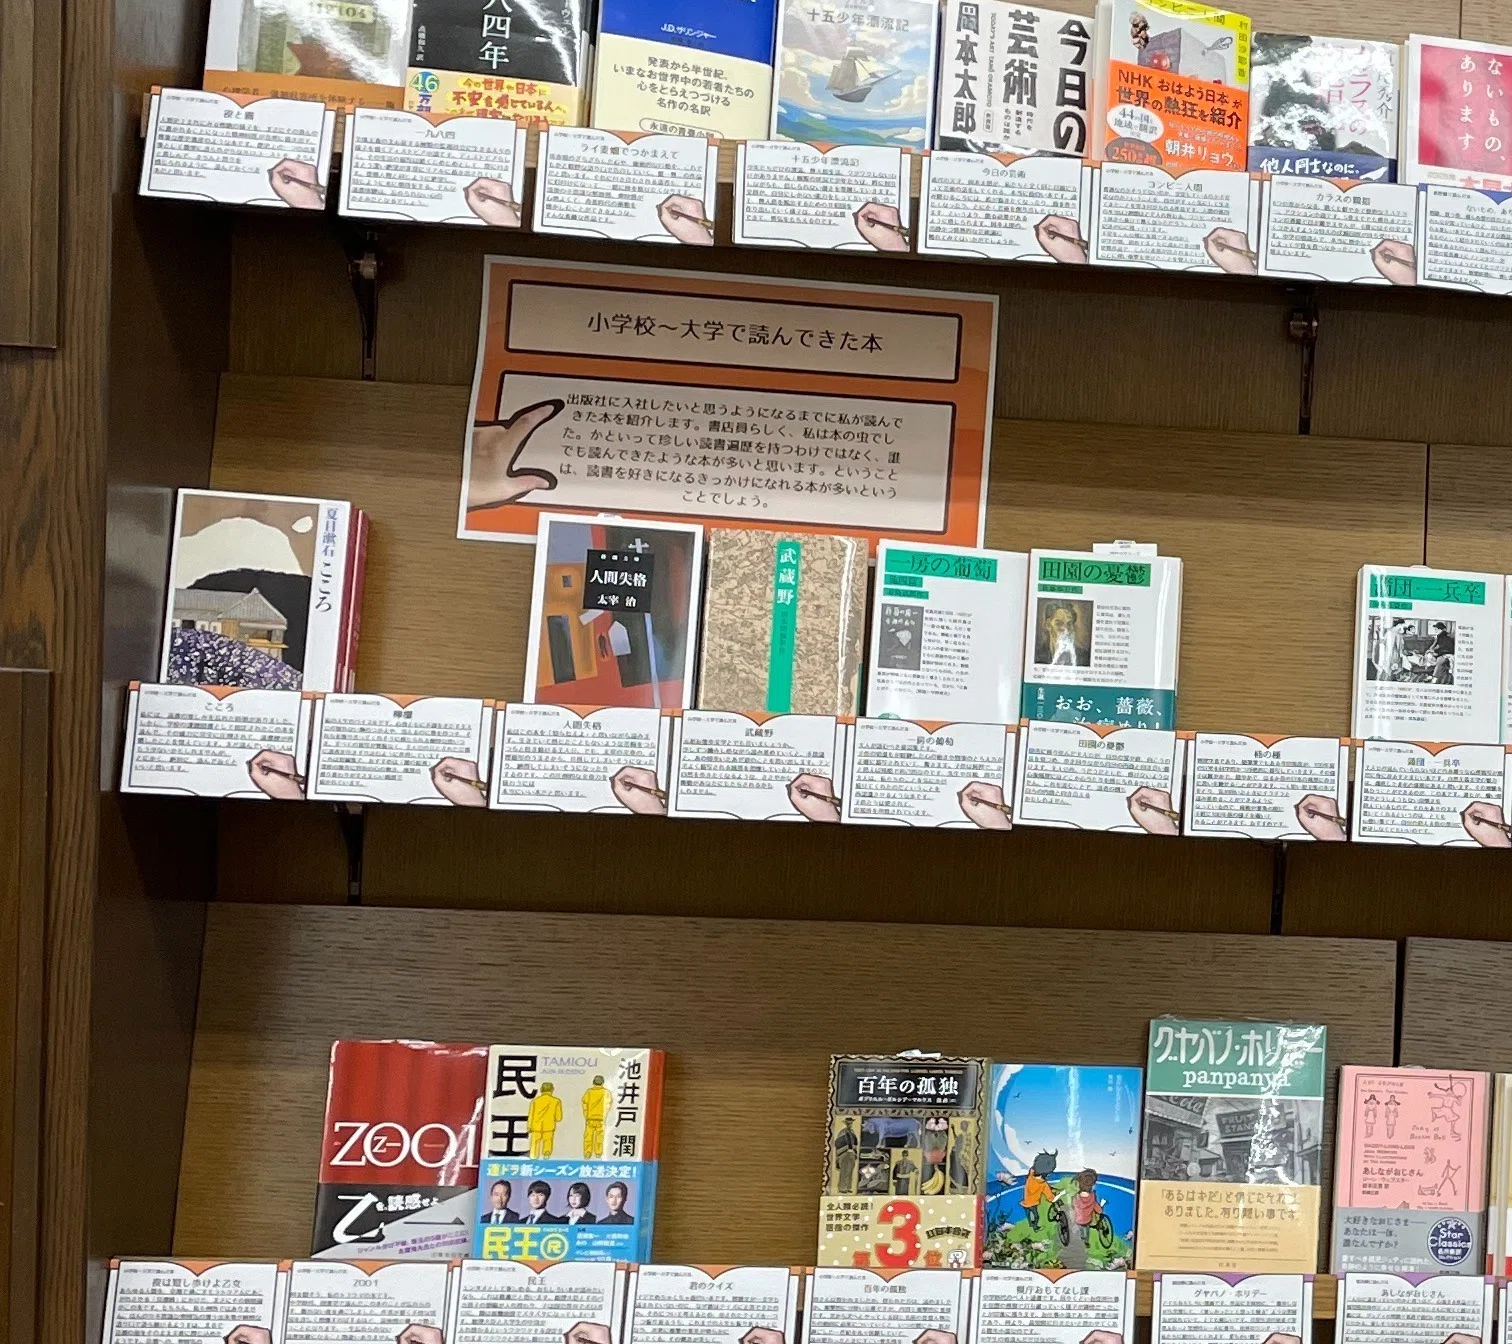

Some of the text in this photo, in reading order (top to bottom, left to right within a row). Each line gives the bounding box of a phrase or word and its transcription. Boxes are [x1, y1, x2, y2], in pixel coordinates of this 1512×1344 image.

[953, 2, 979, 134] 岡本太郎
[1003, 9, 1040, 108] 芸術
[1118, 68, 1152, 90] NHK
[1053, 19, 1091, 154] 今日の
[1457, 54, 1477, 151] あります
[1485, 58, 1507, 161] ないもの、
[588, 312, 883, 353] 小学校～大学で読んできた本
[682, 490, 769, 509] ことでしょう。
[316, 561, 332, 613] こころ
[590, 570, 647, 588] 人間失格
[776, 547, 798, 606] 武蔵野
[1043, 560, 1147, 586] 田園の憂鬱
[543, 1057, 598, 1068] TAMIOU
[1183, 1069, 1291, 1088] panpanya
[488, 1054, 538, 1157] 民王
[613, 1057, 641, 1157] 池井戸潤
[857, 1076, 959, 1096] 百年の孤独
[484, 1226, 541, 1260] 民王
[875, 1199, 921, 1267] 3
[1440, 1230, 1463, 1240] Star
